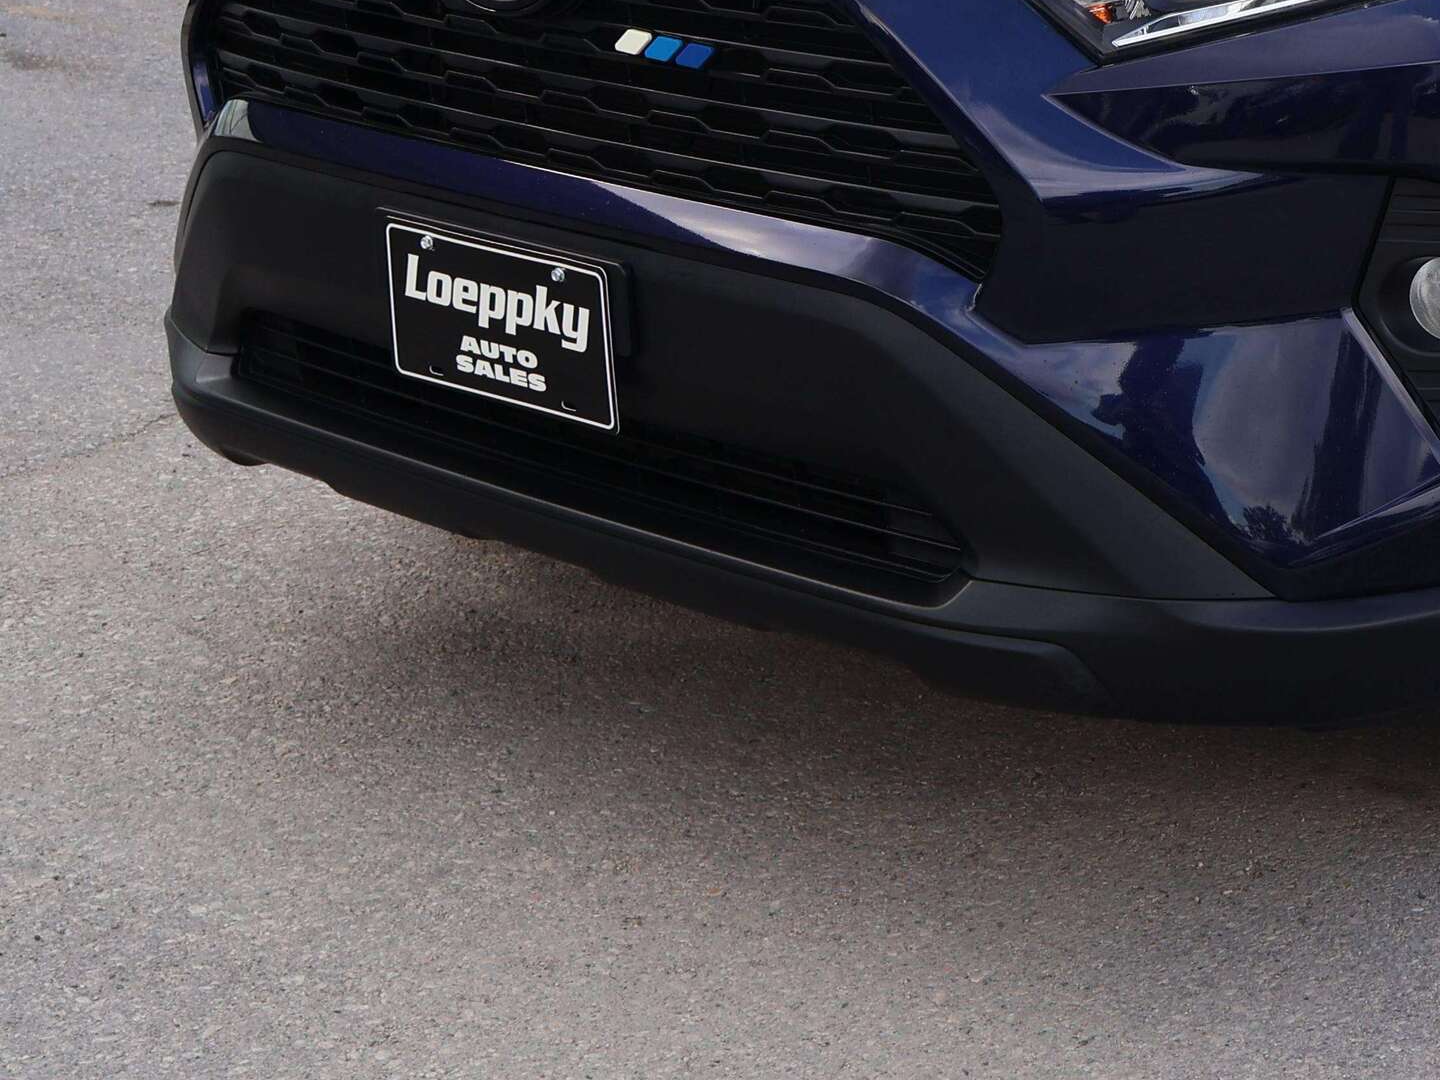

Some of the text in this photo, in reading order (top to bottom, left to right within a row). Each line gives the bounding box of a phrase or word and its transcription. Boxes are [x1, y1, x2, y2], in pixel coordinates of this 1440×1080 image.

[404, 253, 590, 353] Loeppky
[460, 335, 538, 369] AUTO
[455, 354, 547, 392] SALES
